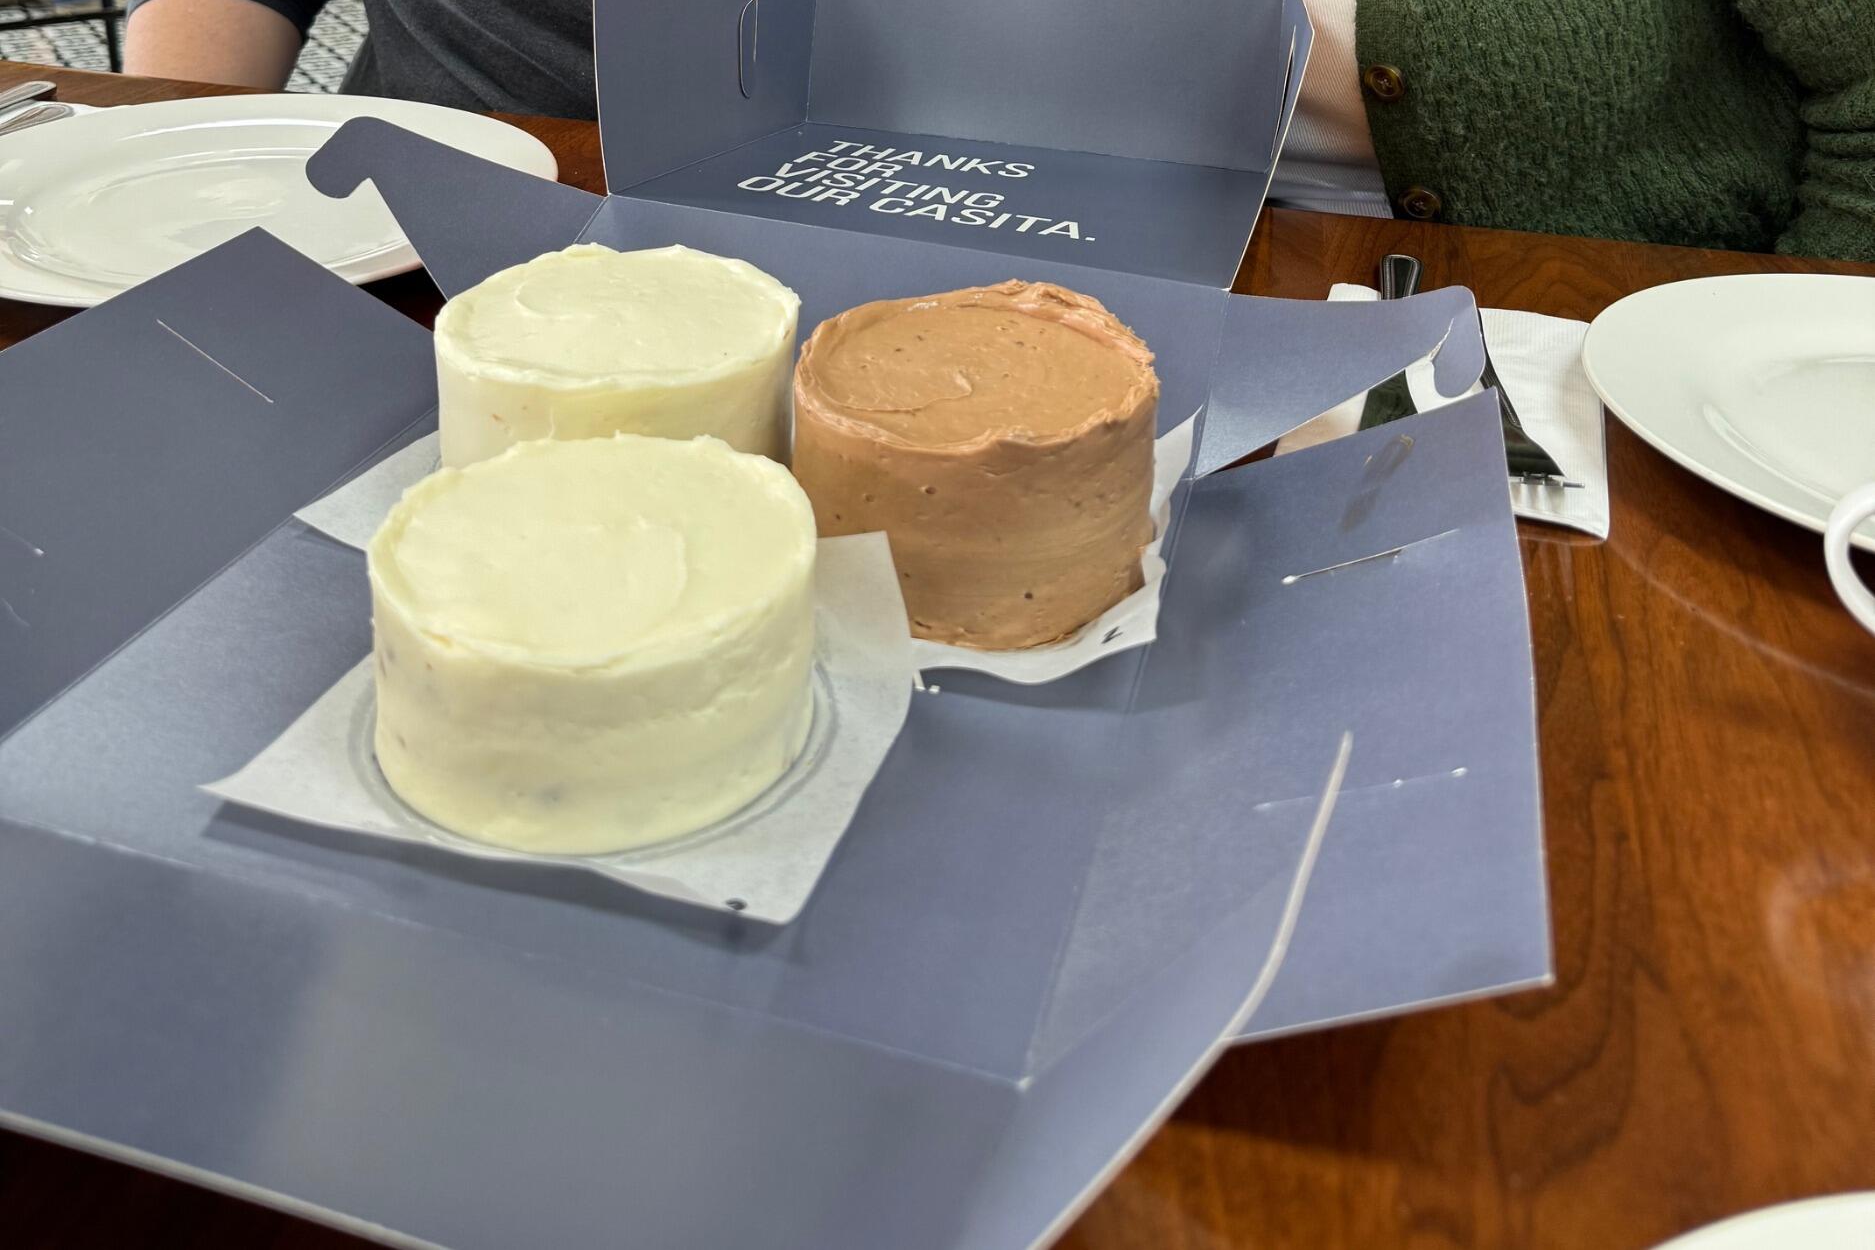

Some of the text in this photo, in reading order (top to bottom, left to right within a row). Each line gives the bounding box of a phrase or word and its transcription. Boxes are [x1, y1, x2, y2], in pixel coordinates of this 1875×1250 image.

[793, 151, 903, 178] FOR
[827, 140, 1035, 178] THANKS
[774, 163, 1005, 208] VISITING
[736, 176, 1097, 241] OUR CASITA.
